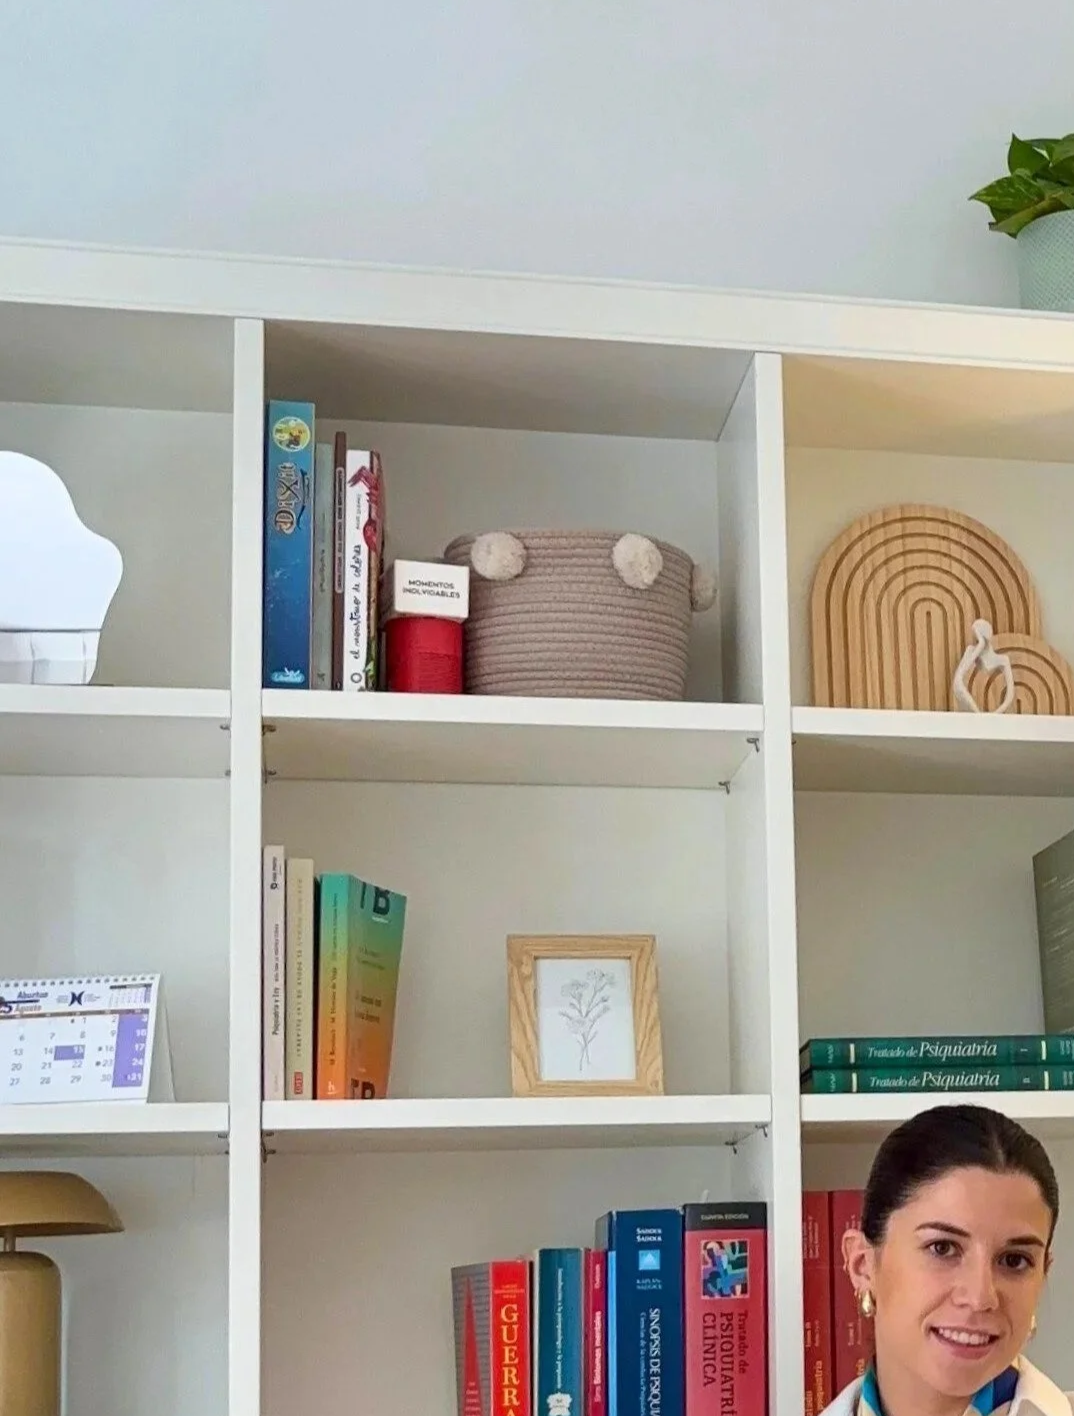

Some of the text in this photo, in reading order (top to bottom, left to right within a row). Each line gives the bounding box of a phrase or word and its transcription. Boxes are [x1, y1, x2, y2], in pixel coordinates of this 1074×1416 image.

[408, 579, 455, 589] MOMENTOS
[402, 588, 460, 599] INOLVIDABLES
[136, 1029, 146, 1037] 10
[14, 1048, 23, 1056] 13
[44, 1047, 53, 1055] 14
[135, 1043, 145, 1051] 17
[868, 1040, 997, 1062] Tratado de Psiquiatría
[11, 1063, 22, 1071] 20
[41, 1061, 52, 1069] 21
[72, 1061, 83, 1069] 22
[132, 1058, 143, 1066] 24
[10, 1078, 20, 1086] 27
[40, 1077, 51, 1085] 28
[70, 1075, 82, 1084] 29
[870, 1069, 1000, 1091] Tratado de Psiquiatría
[649, 1307, 661, 1357] SINOPSIS
[703, 1313, 717, 1387] CLÍNICA
[737, 1311, 750, 1374] Tratado de
[649, 1358, 661, 1375] DE
